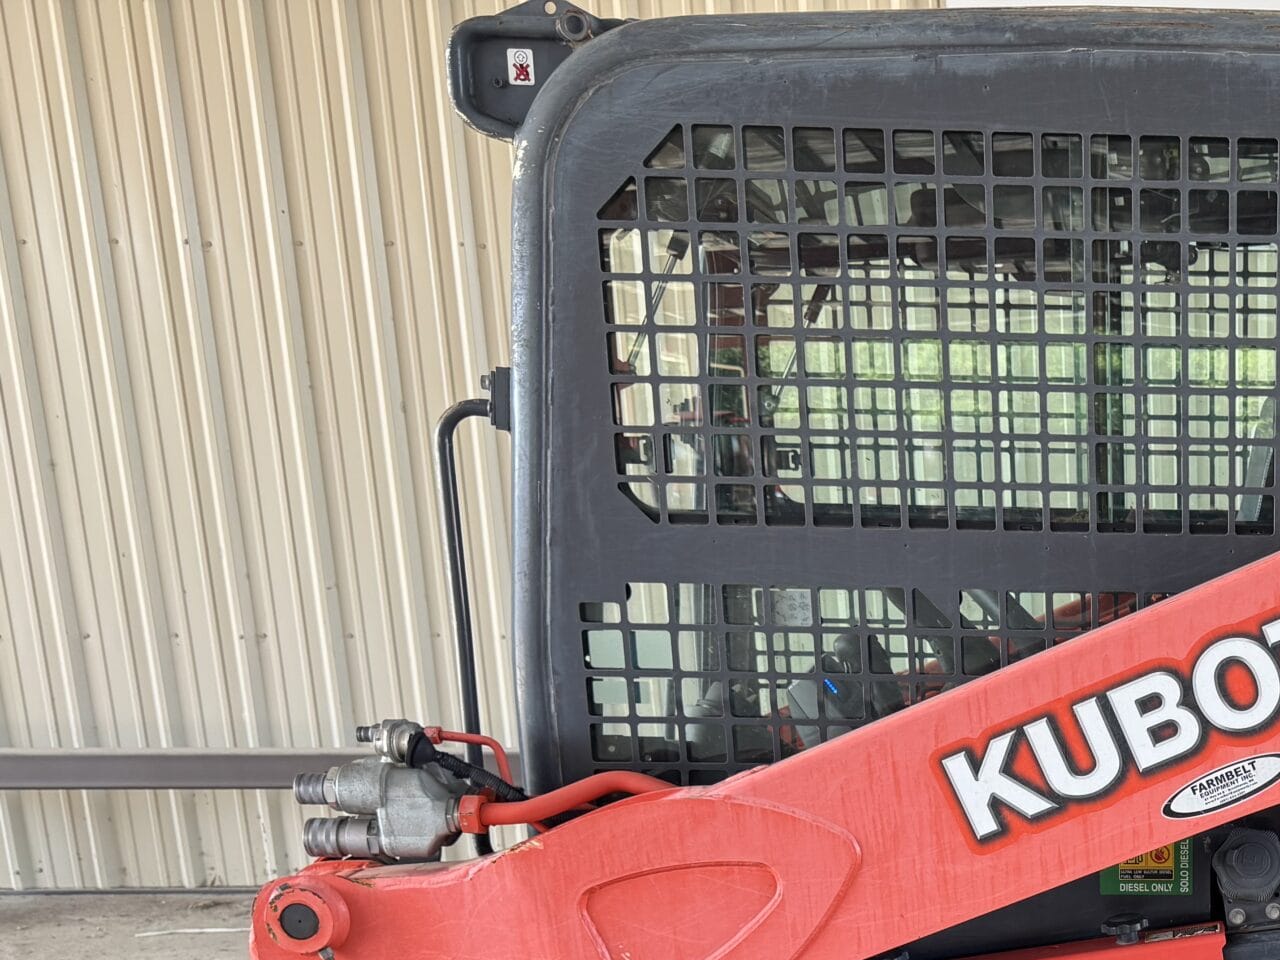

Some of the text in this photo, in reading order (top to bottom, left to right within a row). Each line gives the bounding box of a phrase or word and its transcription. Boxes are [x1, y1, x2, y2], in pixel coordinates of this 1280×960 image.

[1191, 760, 1256, 795] FARMBELT
[1200, 778, 1239, 798] EQUIPMENT
[1241, 772, 1256, 782] INC.
[1179, 839, 1189, 893] SOLO DIESEL
[1119, 883, 1173, 892] DIESEL ONLY
